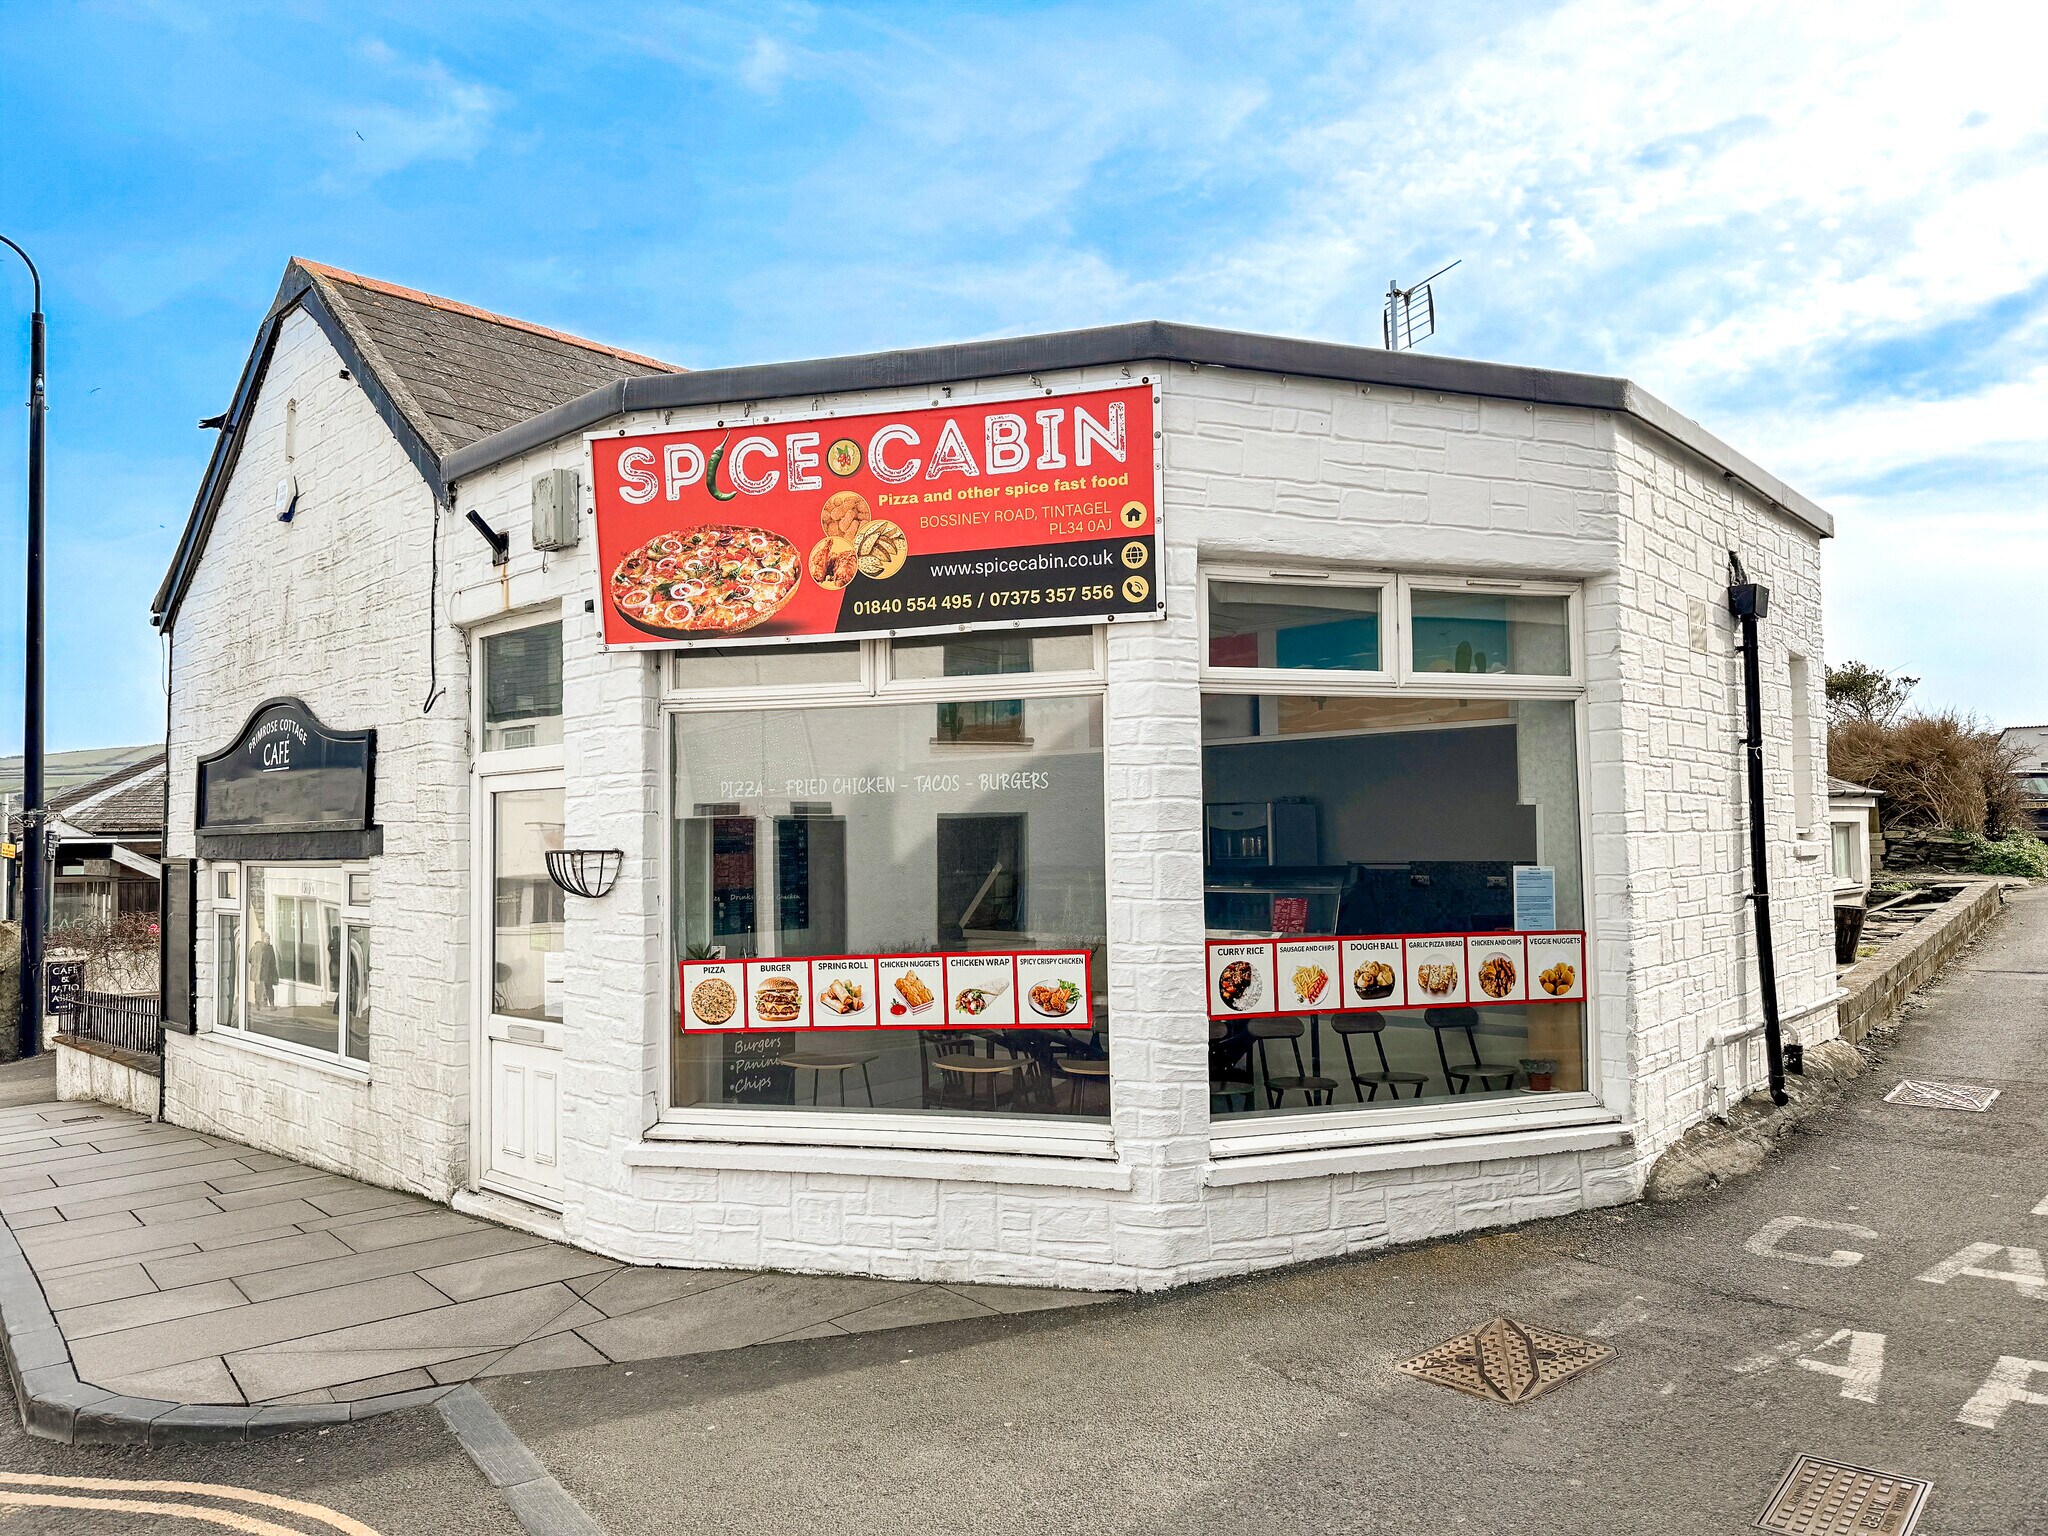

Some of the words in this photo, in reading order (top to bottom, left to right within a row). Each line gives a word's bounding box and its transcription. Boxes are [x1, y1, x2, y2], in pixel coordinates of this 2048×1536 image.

[618, 428, 822, 504] SPICE
[868, 402, 1126, 484] CABIN
[878, 494, 919, 507] Pizza
[924, 488, 953, 504] and
[957, 486, 1000, 502] other
[1004, 480, 1049, 498] spice
[1053, 477, 1086, 493] fast
[1091, 472, 1129, 488] food
[919, 511, 991, 529] BOSSINEY
[994, 507, 1038, 522] ROAD,
[1041, 501, 1112, 519] TINTAGEL
[1049, 521, 1084, 536] PL34
[1087, 518, 1112, 533] 0AJ
[930, 549, 1114, 577] www.spicecabin.co.uk
[853, 599, 902, 615] 01840
[906, 596, 937, 612] 554
[941, 593, 973, 609] 495
[989, 589, 1041, 607] 07375
[1045, 586, 1076, 603] 357
[1081, 584, 1114, 601] 556
[248, 720, 278, 754] PRIMROSE
[280, 719, 308, 746] COTTAGE
[263, 733, 290, 766] CAFÉ
[720, 780, 763, 798] PIZZA
[785, 778, 827, 797] FRIED
[832, 776, 895, 795] CHICKEN
[913, 774, 960, 792] TACOS
[978, 771, 1049, 792] BURGERS
[1350, 942, 1380, 951] DOUGH
[1380, 941, 1399, 950] BALL
[1408, 941, 1428, 949] GARLIC
[1445, 940, 1463, 948] BREAD
[1470, 939, 1490, 947] CHICKEN
[1507, 938, 1522, 946] CHIPS
[1552, 937, 1581, 945] NUGGETS
[1217, 947, 1245, 956] CURRY
[1246, 946, 1265, 955] RICE
[1279, 945, 1305, 953] SAUSAGE
[1318, 944, 1335, 952] CHIPS
[818, 962, 848, 971] SPRING
[848, 961, 868, 970] ROLL
[880, 960, 909, 968] CHICKEN
[909, 960, 940, 968] NUGGETS
[950, 959, 985, 967] CHICKEN
[986, 958, 1010, 967] WRAP
[1019, 958, 1037, 966] SPICY
[1037, 958, 1057, 966] CRISPY
[1057, 957, 1084, 965] CHICKEN
[703, 966, 726, 974] PIZZA
[760, 964, 792, 972] BURGER
[51, 983, 80, 993] PATIO
[734, 1037, 781, 1054] Burgers
[735, 1075, 772, 1093] Chips
[1859, 1496, 1892, 1530] WATER
